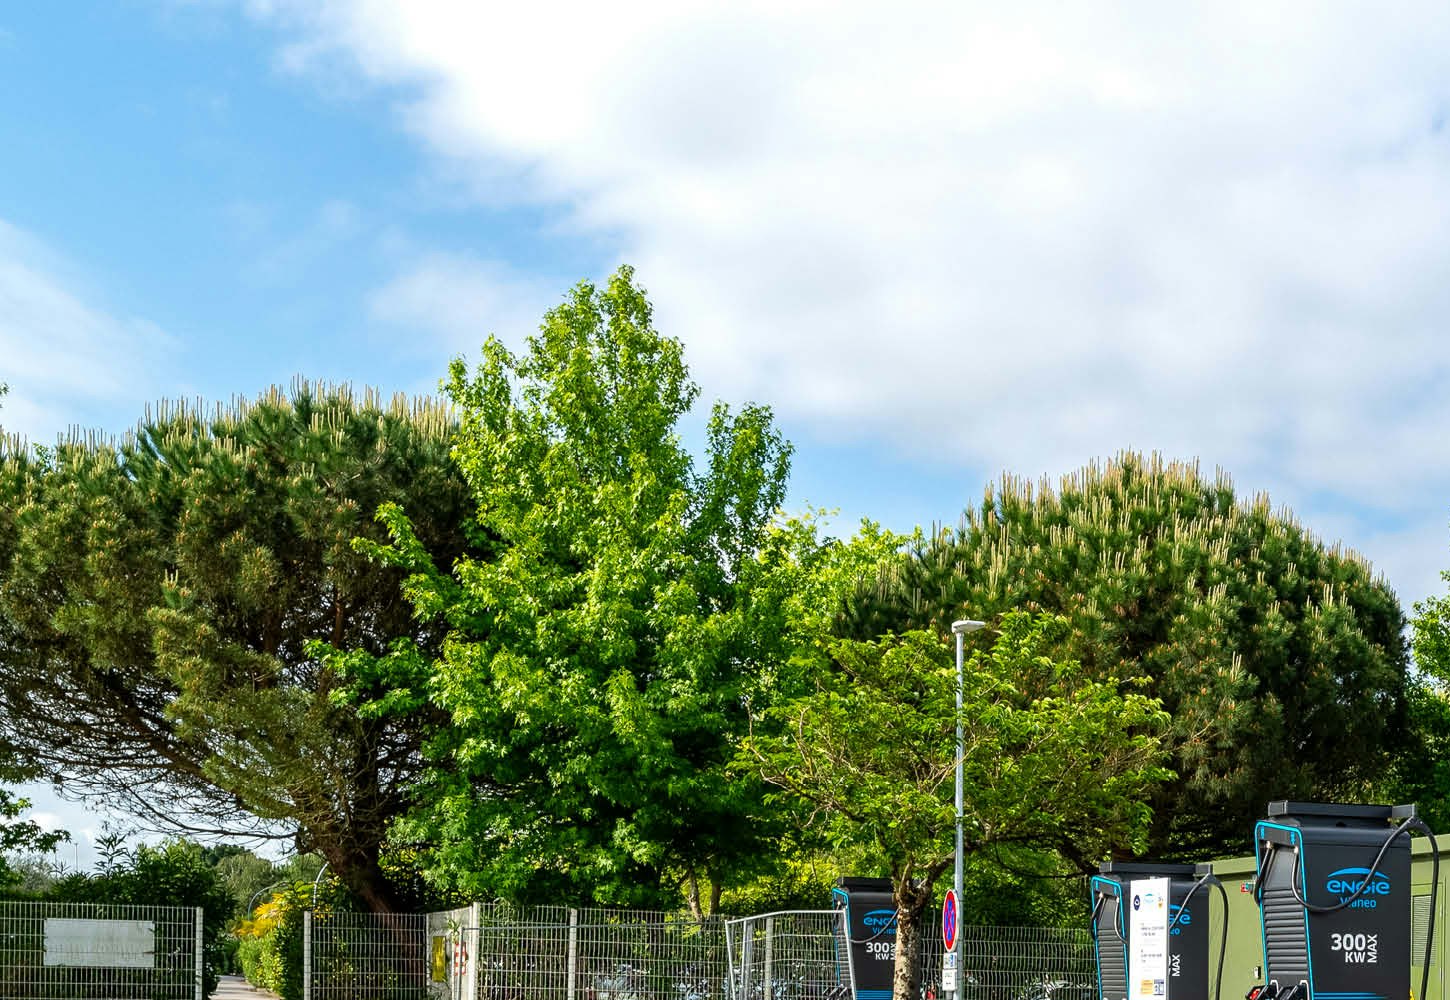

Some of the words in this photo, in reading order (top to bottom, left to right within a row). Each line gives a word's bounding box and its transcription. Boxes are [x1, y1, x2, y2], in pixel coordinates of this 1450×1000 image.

[866, 942, 890, 953] 300
[1331, 933, 1366, 951] 300
[1367, 934, 1378, 963] MAX
[1172, 954, 1181, 977] MAX
[1345, 951, 1366, 963] KW
